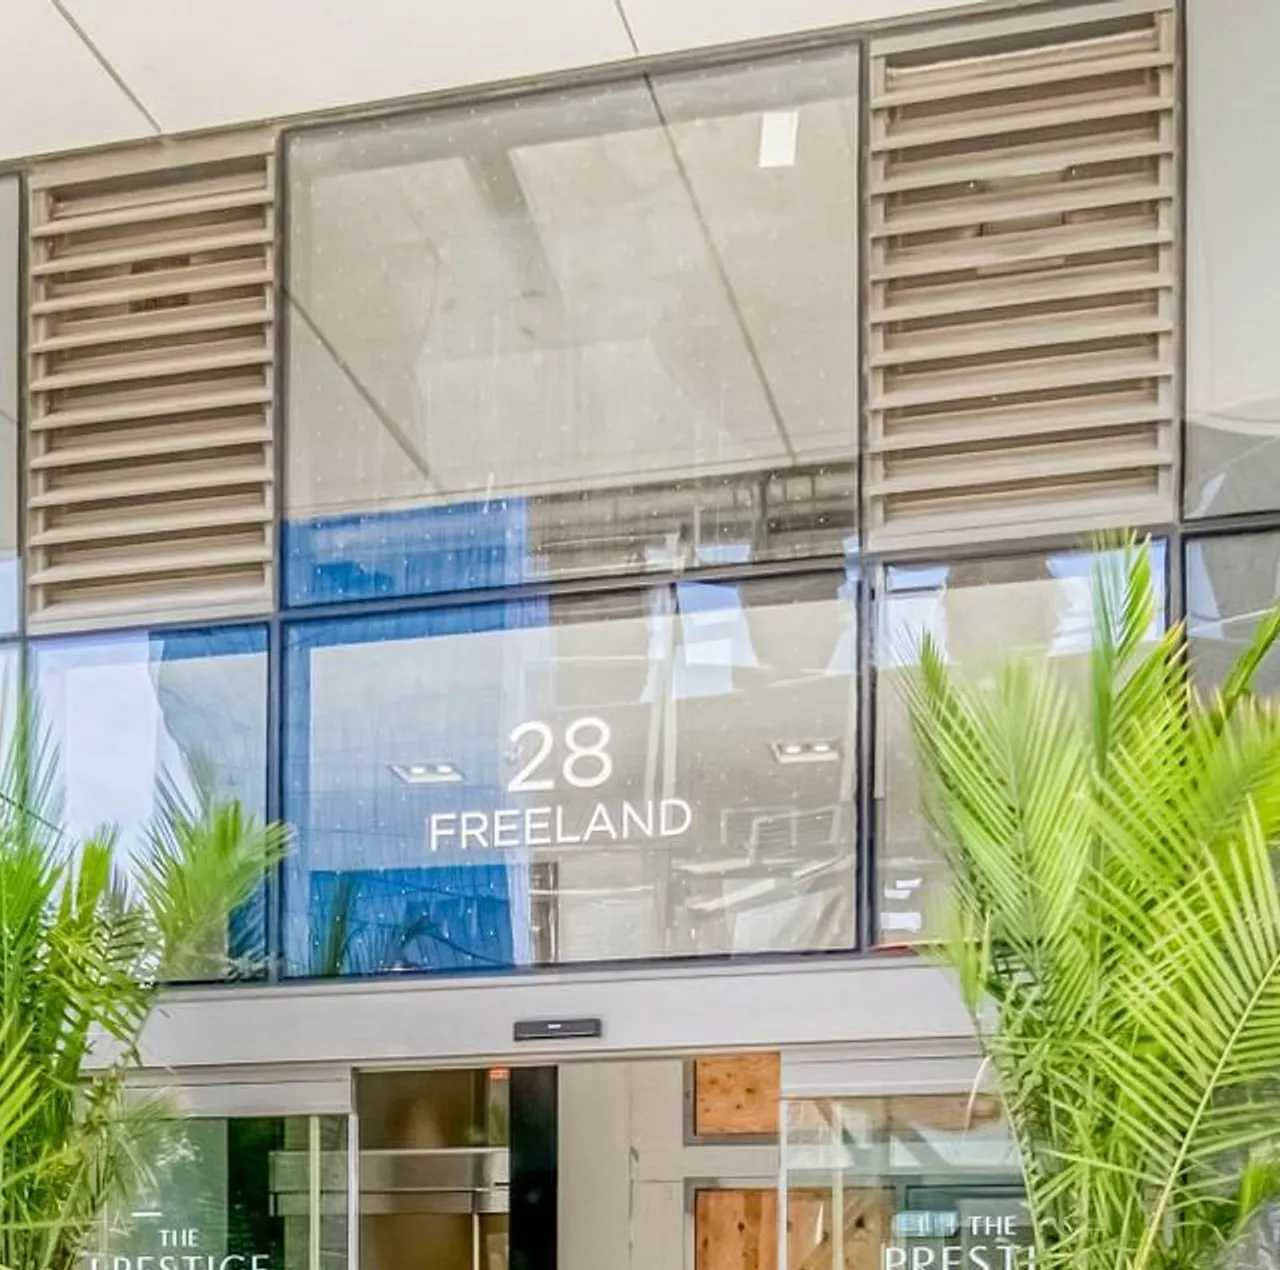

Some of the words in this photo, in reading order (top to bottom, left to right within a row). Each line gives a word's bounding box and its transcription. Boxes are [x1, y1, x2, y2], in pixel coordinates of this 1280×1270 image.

[507, 716, 614, 792] 28
[429, 799, 693, 851] FREELAND
[158, 1229, 198, 1247] THE
[968, 1215, 1017, 1236] THE
